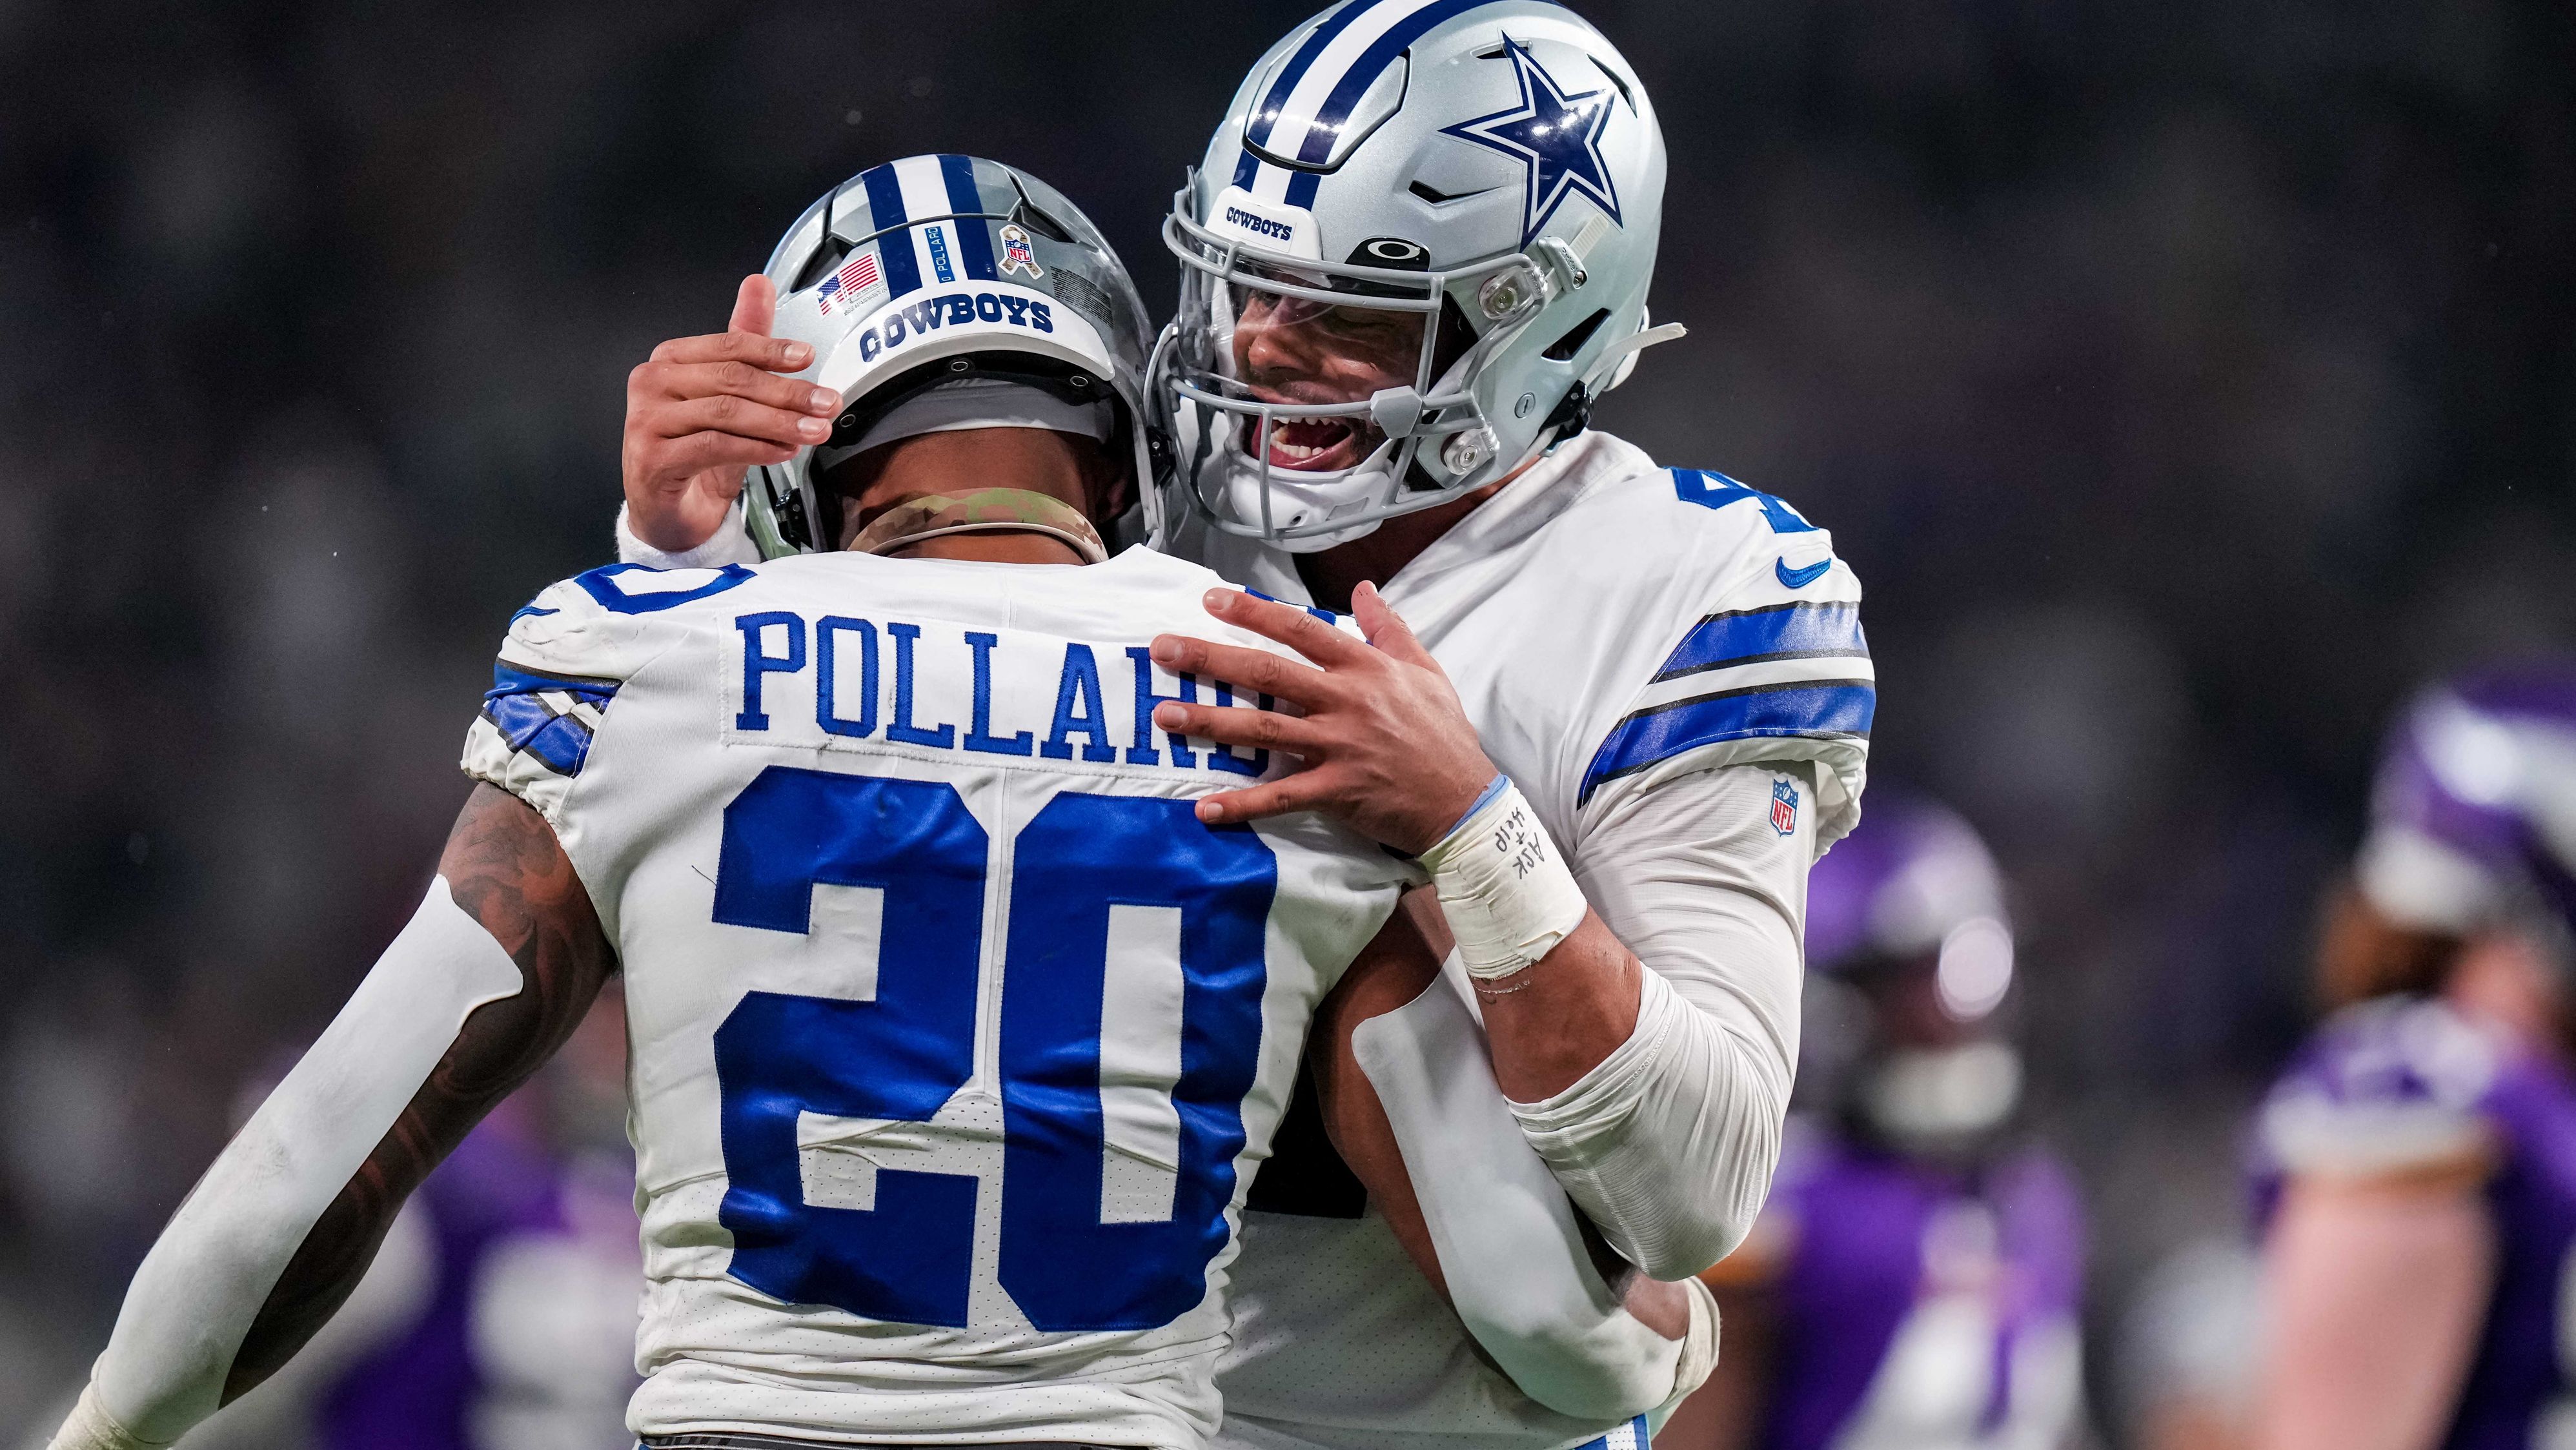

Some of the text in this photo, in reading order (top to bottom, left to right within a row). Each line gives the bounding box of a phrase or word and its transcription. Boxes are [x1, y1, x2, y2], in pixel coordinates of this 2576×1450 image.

[1226, 206, 1293, 241] COWBOYS
[928, 227, 948, 271] POLLARD
[1008, 247, 1030, 261] NFL
[859, 293, 1053, 363] COWBOYS
[1772, 799, 1793, 831] NFL
[1512, 832, 1545, 879] ASK
[711, 764, 1278, 1332] 20
